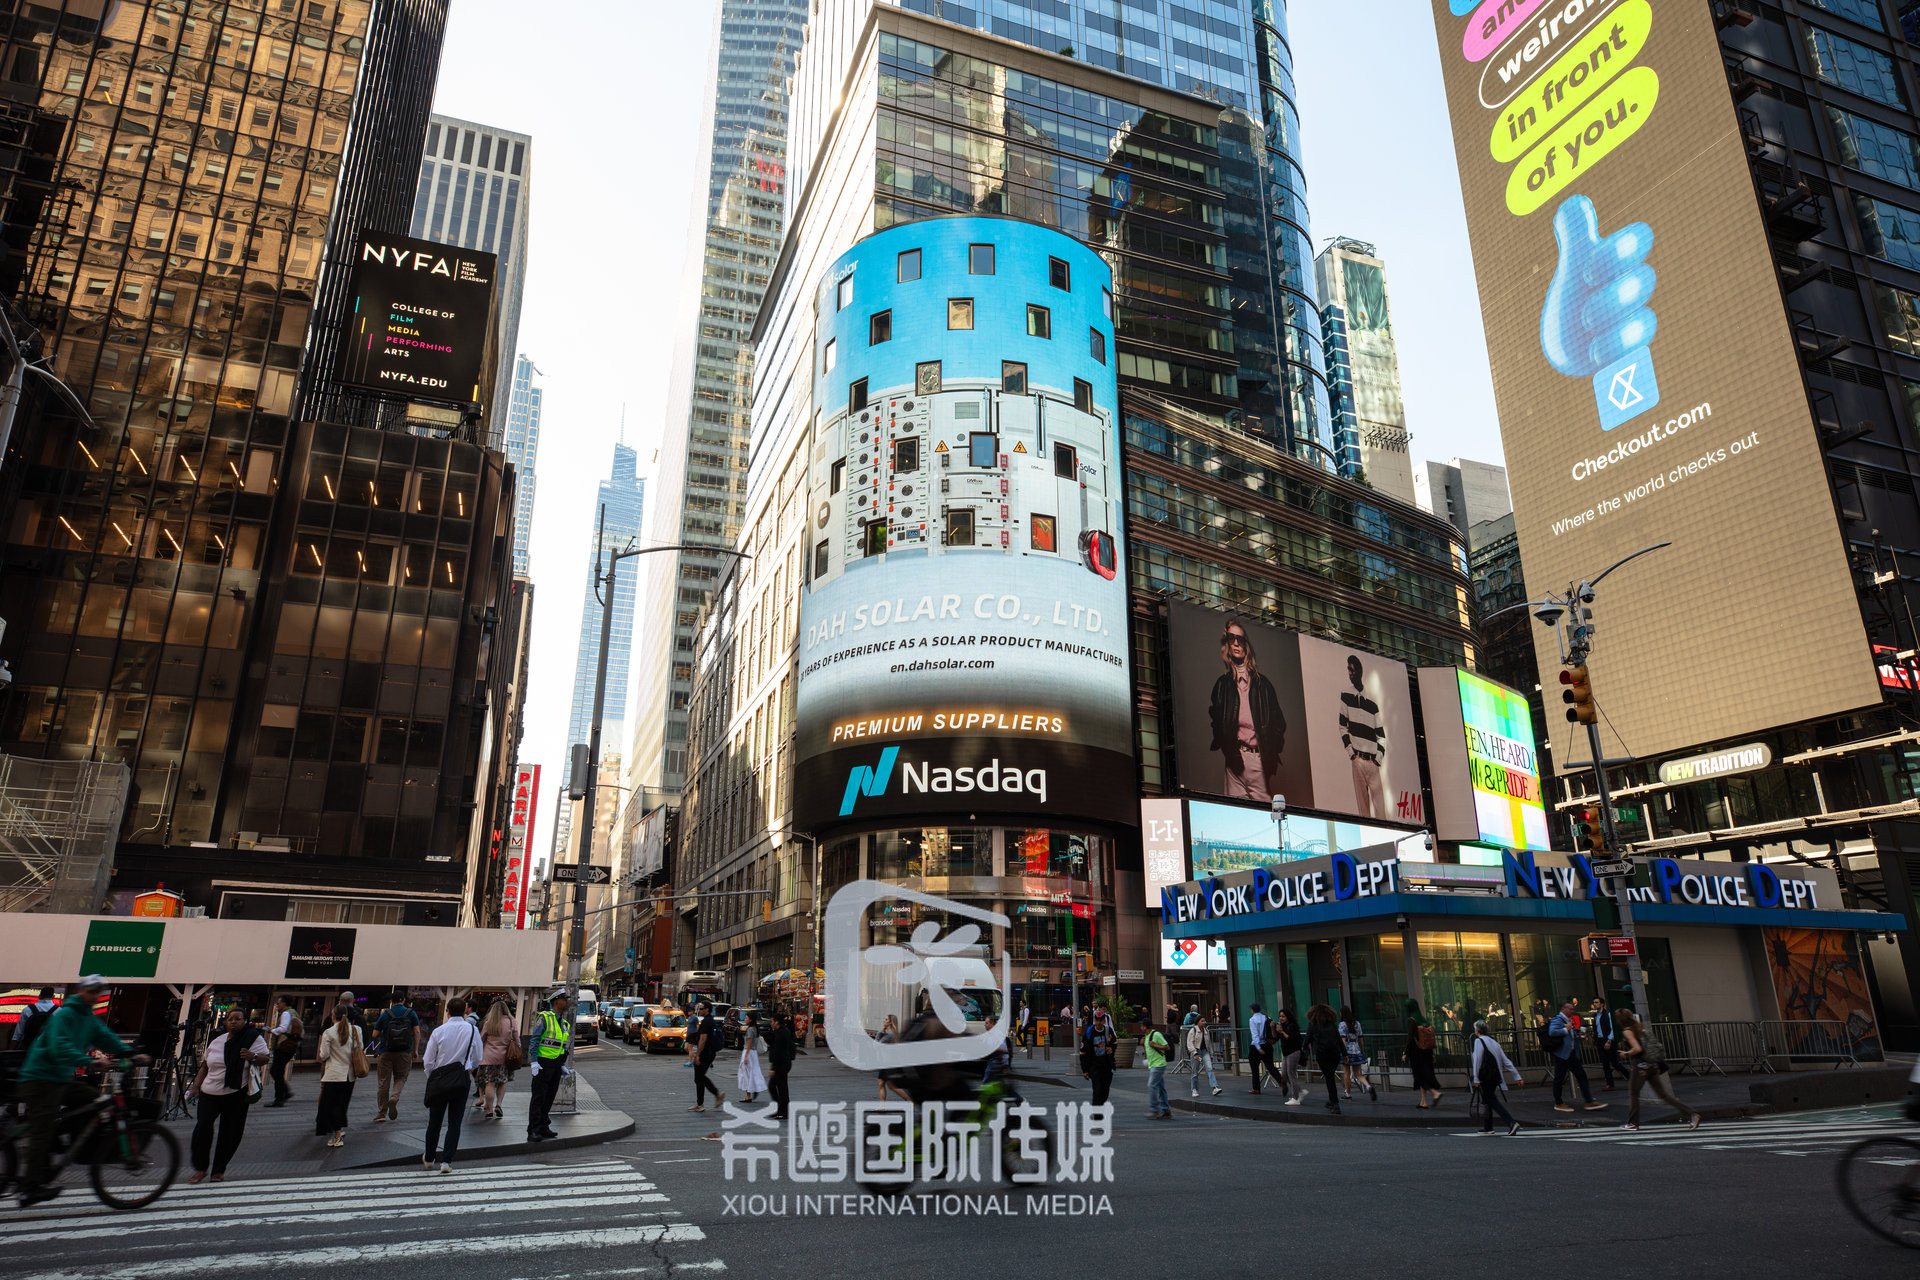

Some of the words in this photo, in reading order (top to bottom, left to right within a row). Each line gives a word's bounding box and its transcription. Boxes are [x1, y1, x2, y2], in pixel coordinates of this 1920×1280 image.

[1482, 0, 1527, 39] an
[1507, 107, 1537, 142] in
[1541, 22, 1628, 112] front
[1526, 147, 1557, 192] of
[1564, 98, 1639, 170] you.
[363, 242, 450, 277] NYFA
[460, 275, 488, 284] ACADEMY
[390, 314, 414, 323] FILM
[392, 303, 438, 317] COLLEGE
[386, 336, 452, 353] PERFORMING
[388, 325, 420, 337] MEDIA
[384, 348, 410, 357] ARTS
[380, 370, 448, 388] NYFA.EDU
[1571, 402, 1713, 481] Checkout.com
[1079, 463, 1097, 475] Solar
[1551, 508, 1595, 536] Where
[1597, 497, 1621, 515] the
[1624, 473, 1665, 503] world
[1668, 447, 1727, 484] checks
[1730, 431, 1760, 456] out
[807, 610, 846, 651] DAH
[852, 594, 961, 632] SOLAR
[973, 594, 1041, 626] CO.,
[1053, 600, 1109, 637] LTD.
[804, 659, 821, 678] YEARS
[822, 655, 832, 667] OF
[833, 639, 895, 663] EXPERIENCE
[898, 637, 915, 650] AS
[919, 636, 928, 648] A
[932, 634, 976, 648] SOLAR
[980, 635, 1042, 650] PRODUCT
[1044, 640, 1123, 668] MANUFACTURER
[890, 658, 995, 673] en.dahsolar.com
[833, 715, 923, 743] PREMIUM
[933, 713, 1063, 733] SUPPLIERS
[902, 758, 1047, 803] Nasdaq
[513, 773, 531, 825] PARK
[1397, 791, 1422, 822] H&M
[504, 858, 521, 913] PARK
[561, 869, 578, 877] ONE
[1161, 886, 1198, 924] NEW
[1199, 878, 1250, 919] YORK
[1253, 869, 1325, 911] POLICE
[1332, 853, 1399, 900] DEPT
[1502, 848, 1576, 898] NEW
[1656, 858, 1749, 907] POLICE
[1749, 863, 1816, 910] DEPT
[1027, 906, 1047, 914] Nasdaq
